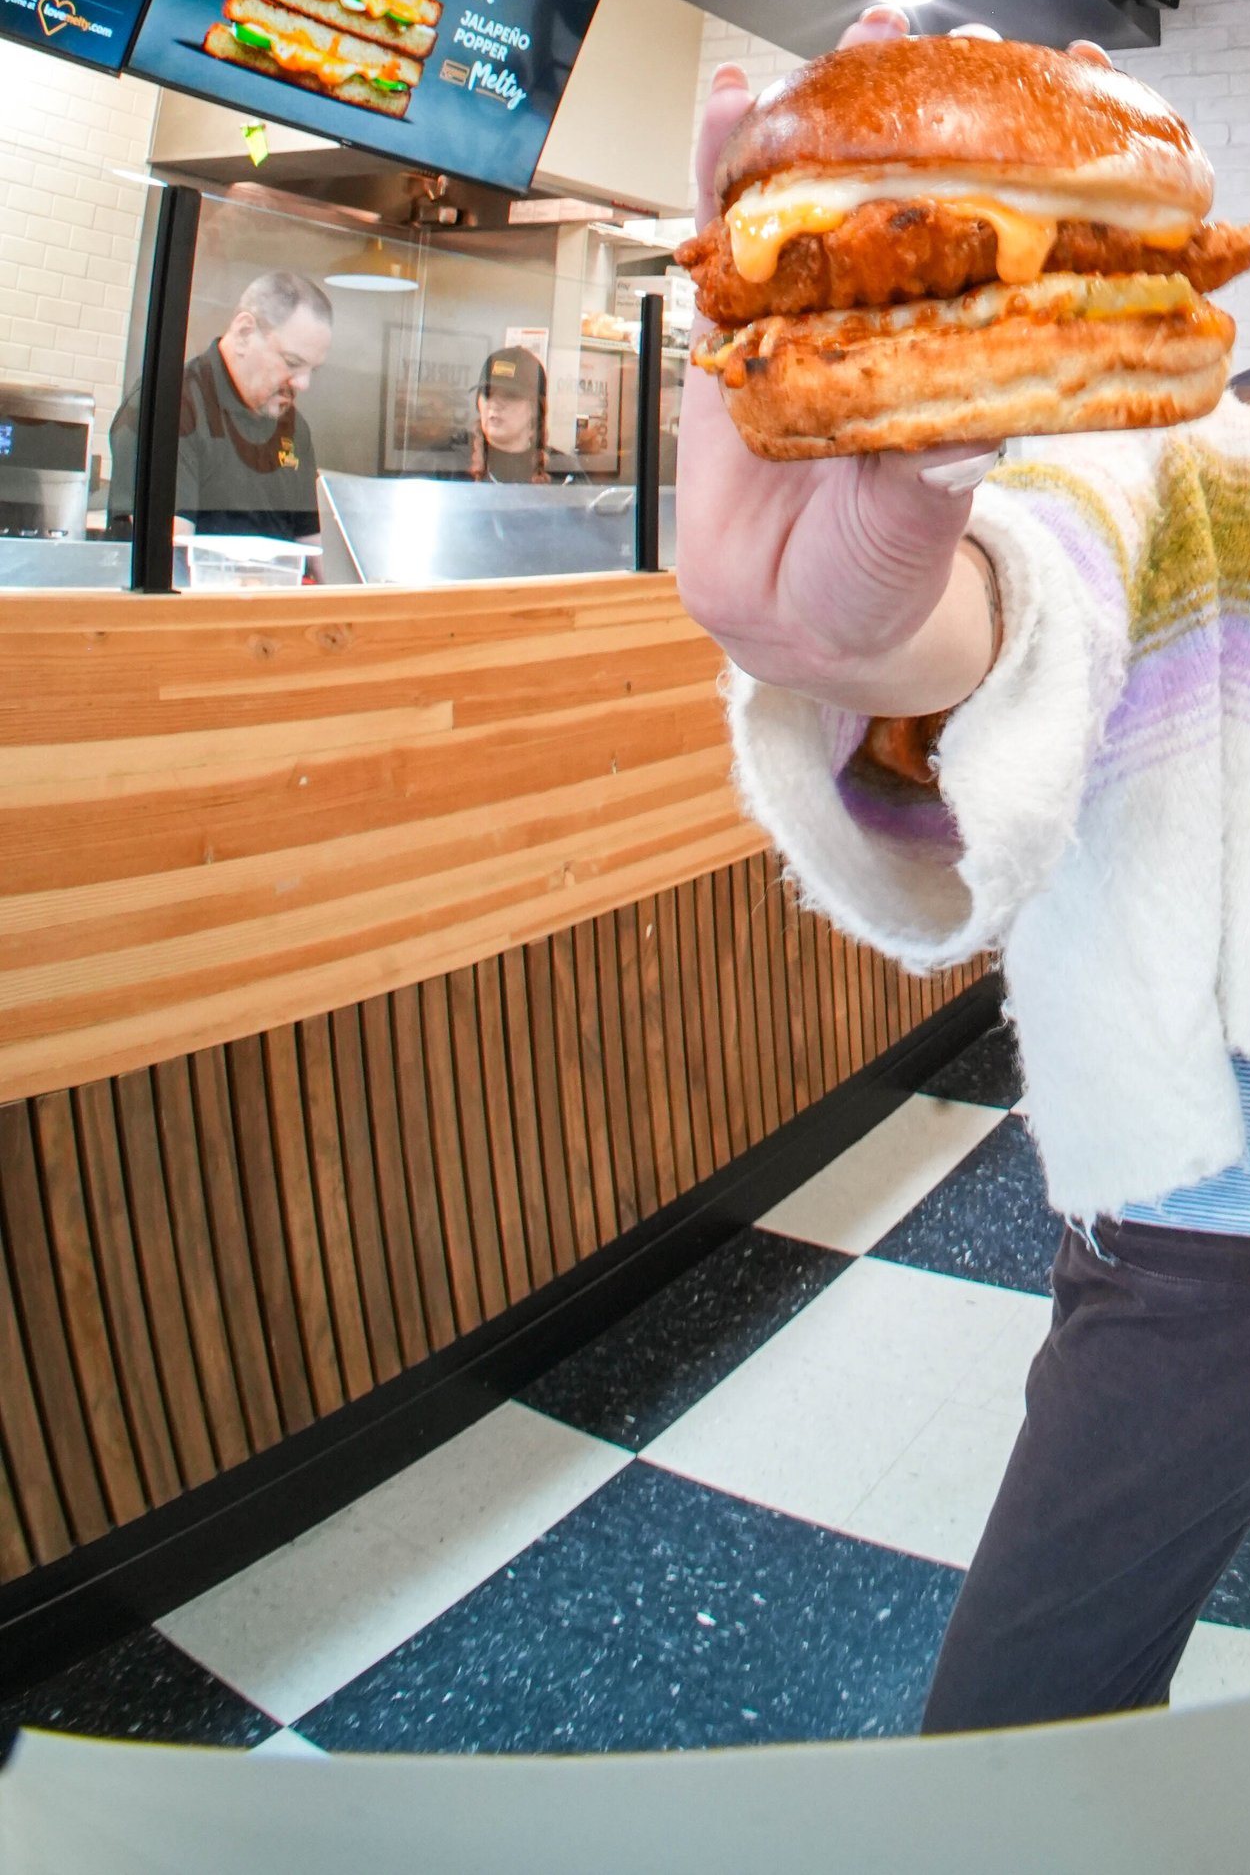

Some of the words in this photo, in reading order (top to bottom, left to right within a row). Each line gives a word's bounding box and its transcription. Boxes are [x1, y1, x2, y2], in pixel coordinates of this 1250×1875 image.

[453, 27, 509, 62] POPPER
[460, 9, 531, 51] JALAPEÑO
[468, 60, 527, 111] Melty
